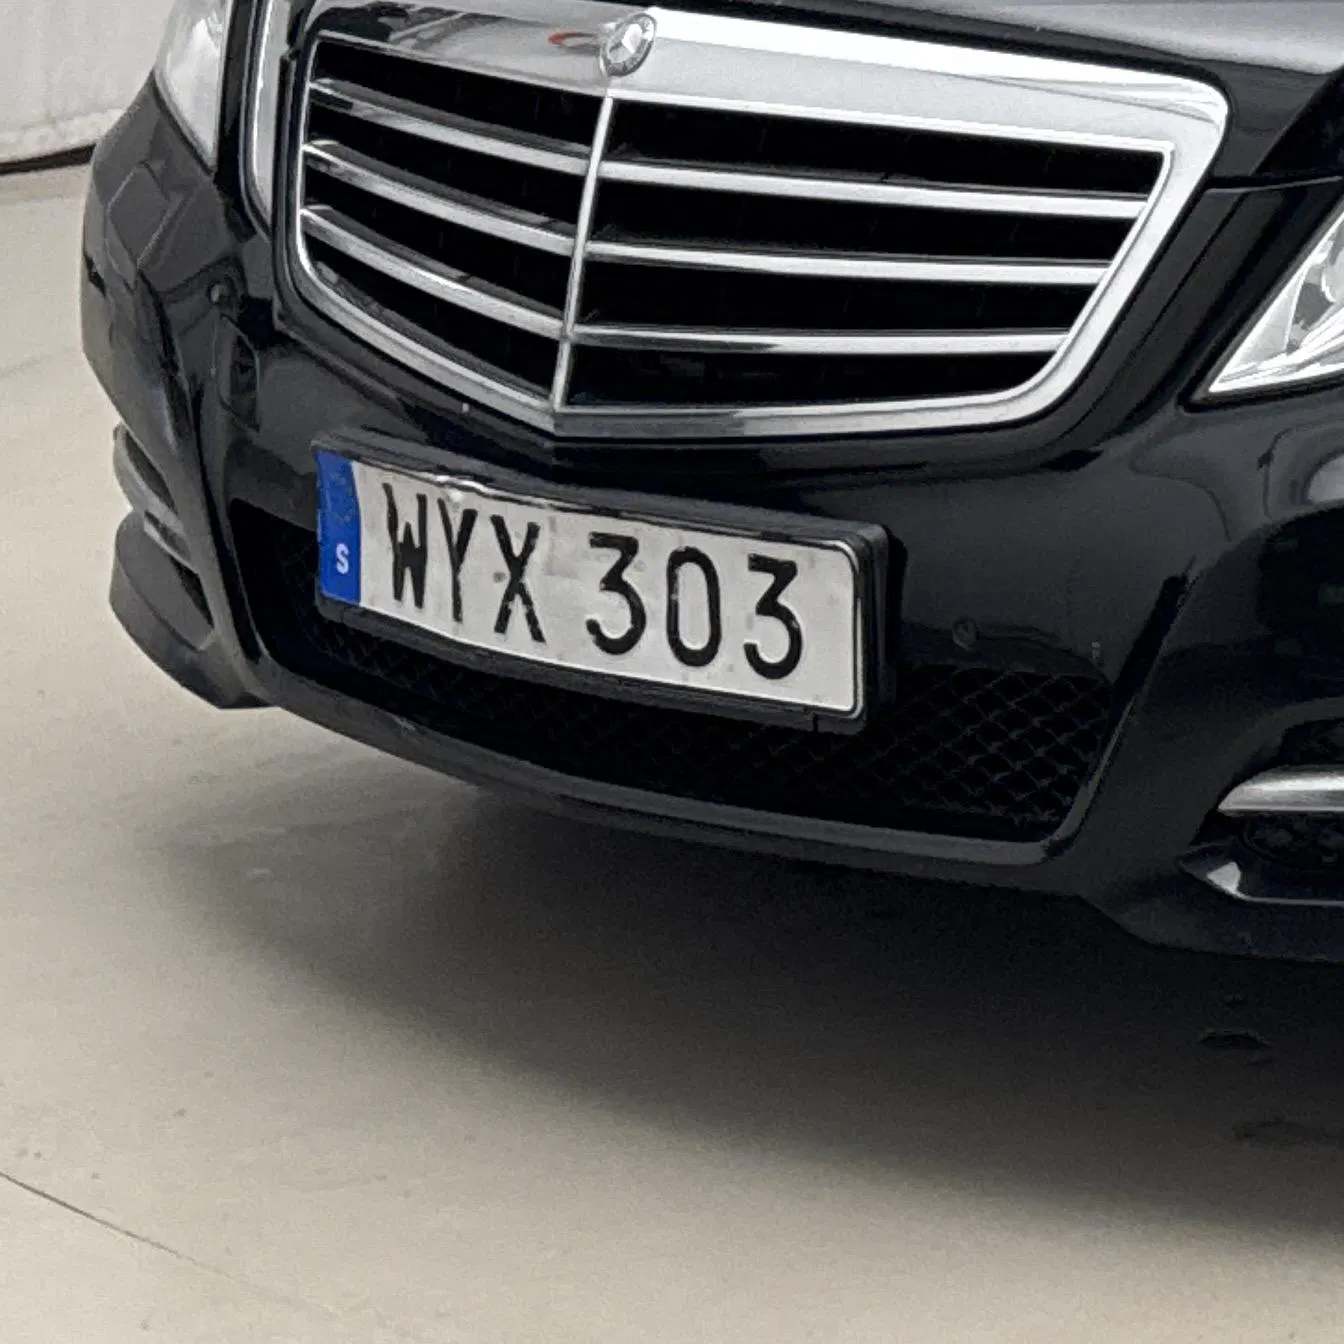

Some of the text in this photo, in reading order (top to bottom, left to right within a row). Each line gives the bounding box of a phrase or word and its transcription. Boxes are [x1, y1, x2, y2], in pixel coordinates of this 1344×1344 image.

[336, 543, 350, 574] S
[382, 482, 804, 680] WYX 303
